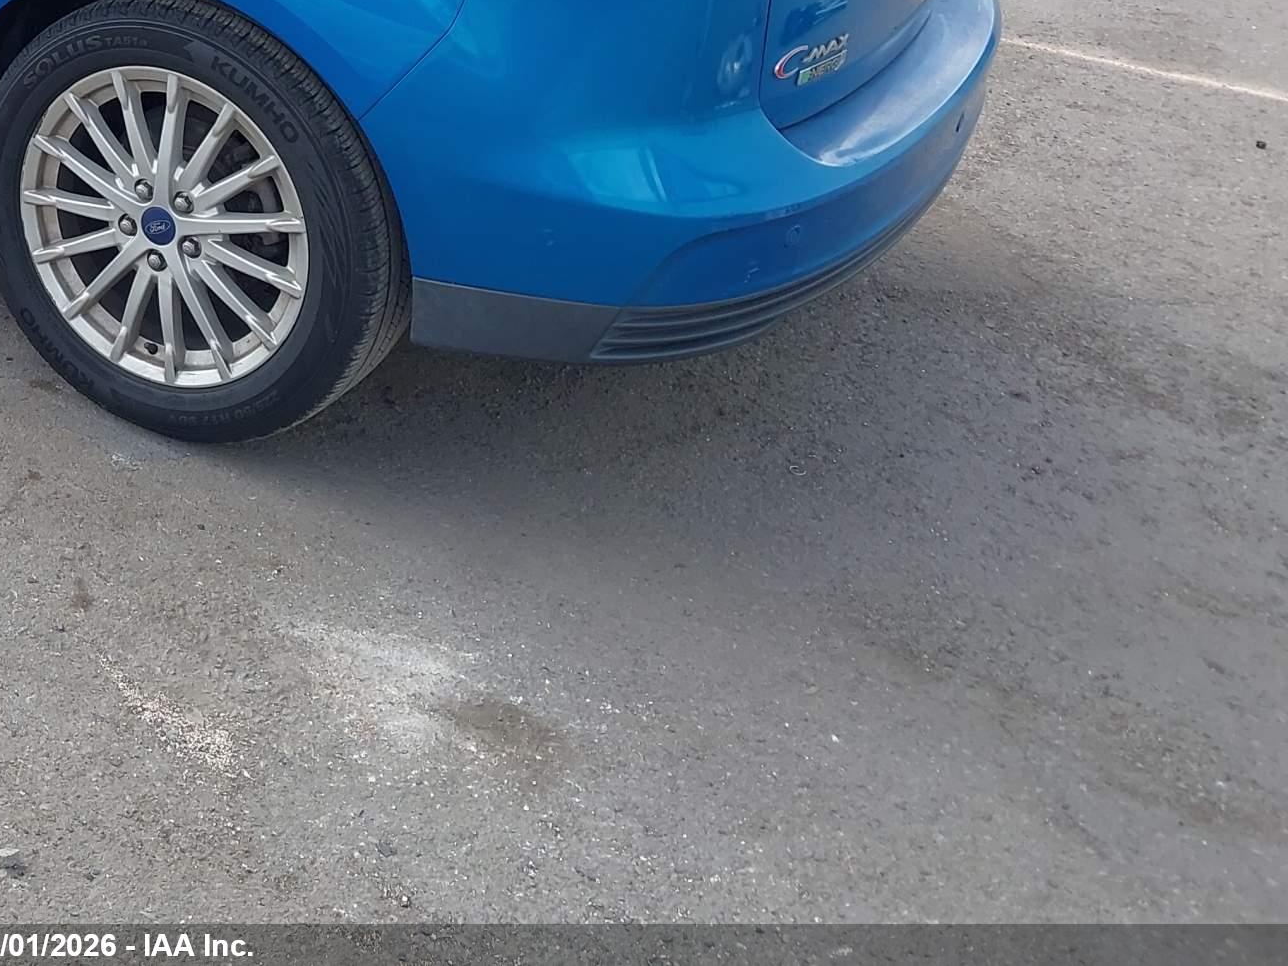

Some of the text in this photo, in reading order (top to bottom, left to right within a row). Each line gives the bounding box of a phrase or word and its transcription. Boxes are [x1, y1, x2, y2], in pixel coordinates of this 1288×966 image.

[23, 34, 105, 90] SOLUS
[774, 33, 849, 79] C-MAX
[211, 55, 300, 143] KUMHO
